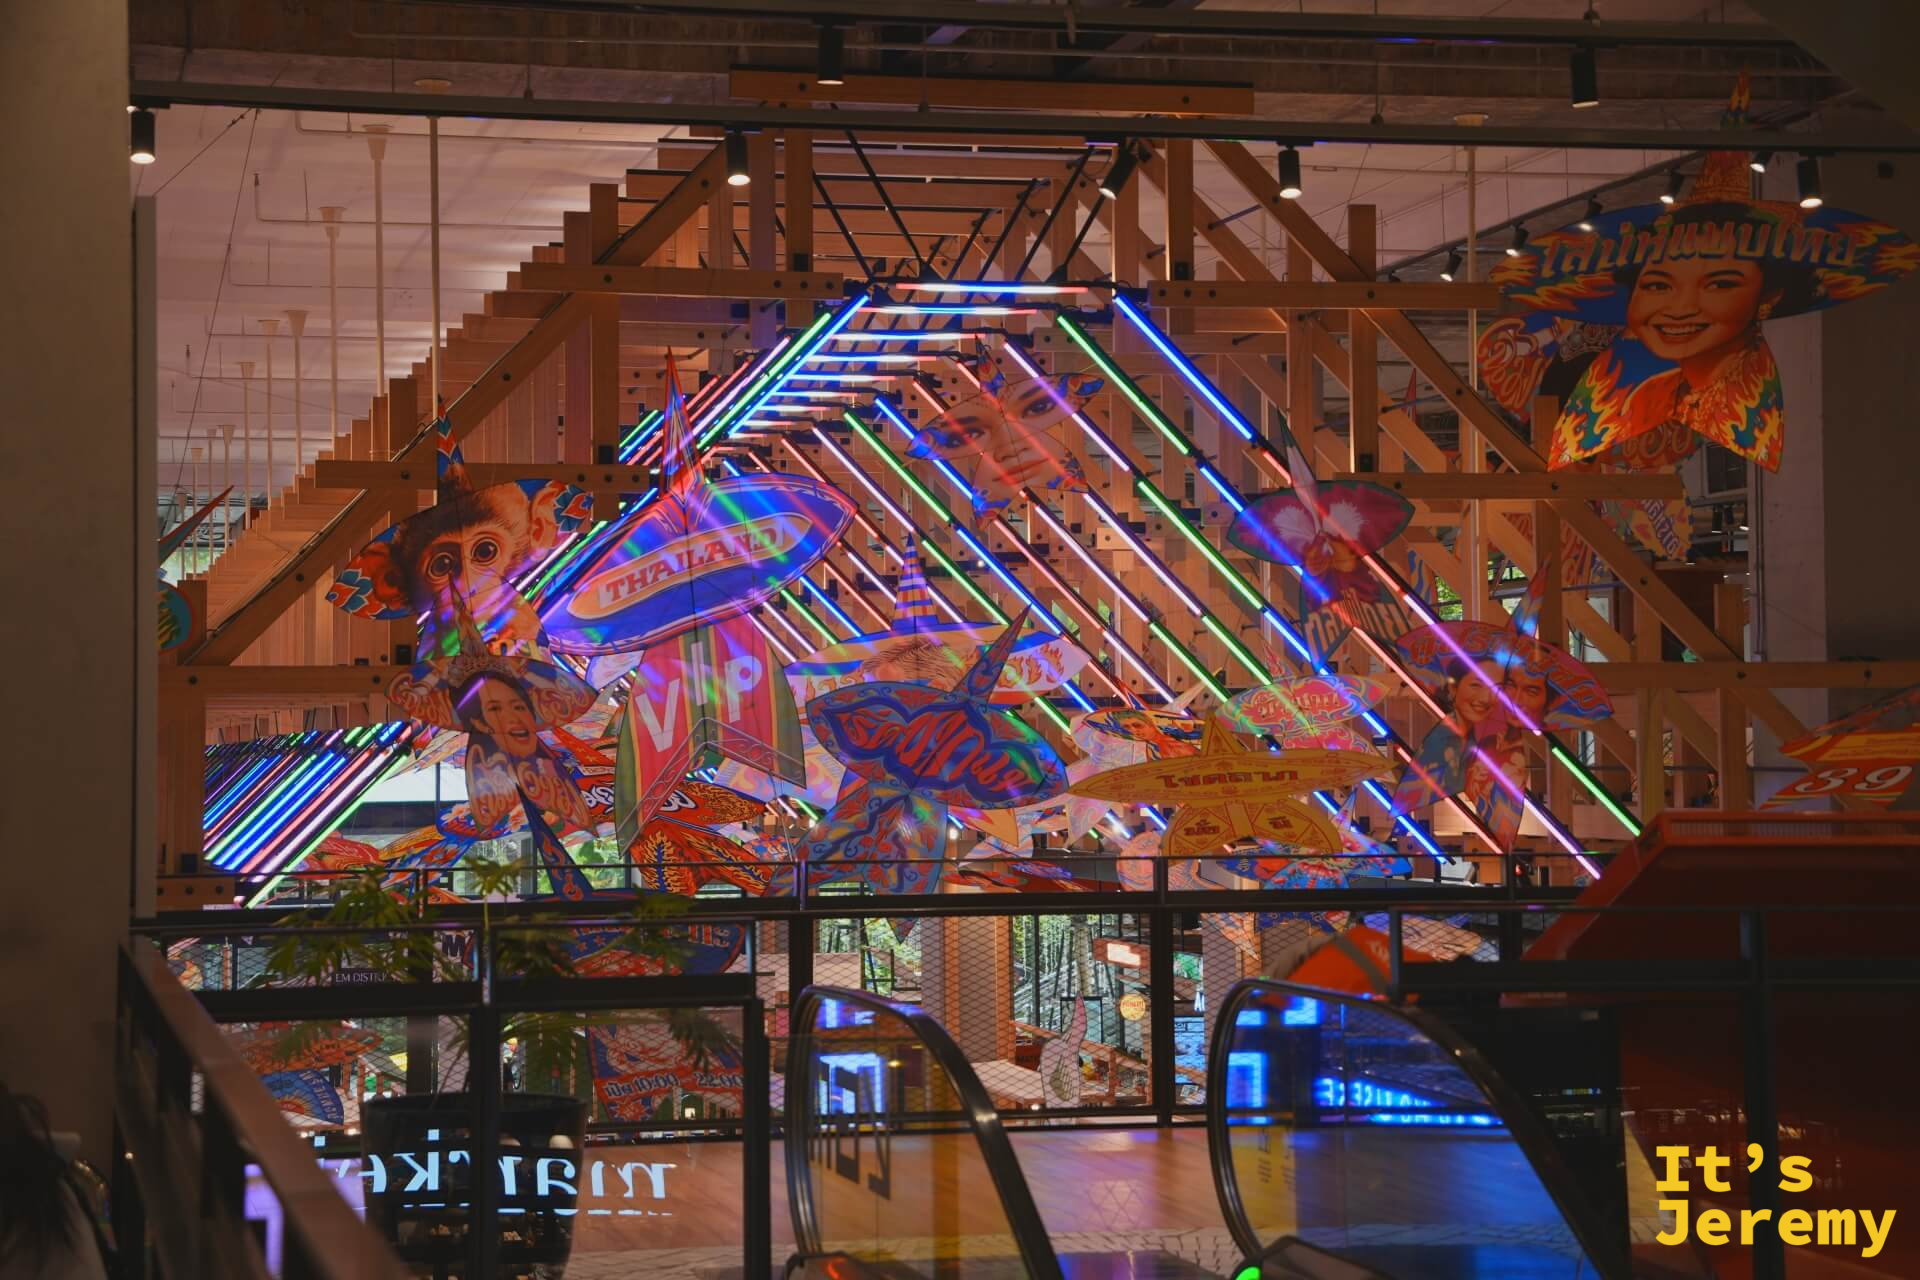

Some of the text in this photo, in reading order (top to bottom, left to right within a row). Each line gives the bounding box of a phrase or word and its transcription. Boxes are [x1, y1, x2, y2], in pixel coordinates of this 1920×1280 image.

[605, 523, 780, 602] THAILAND
[634, 641, 763, 753] VIP
[1794, 764, 1913, 793] 39
